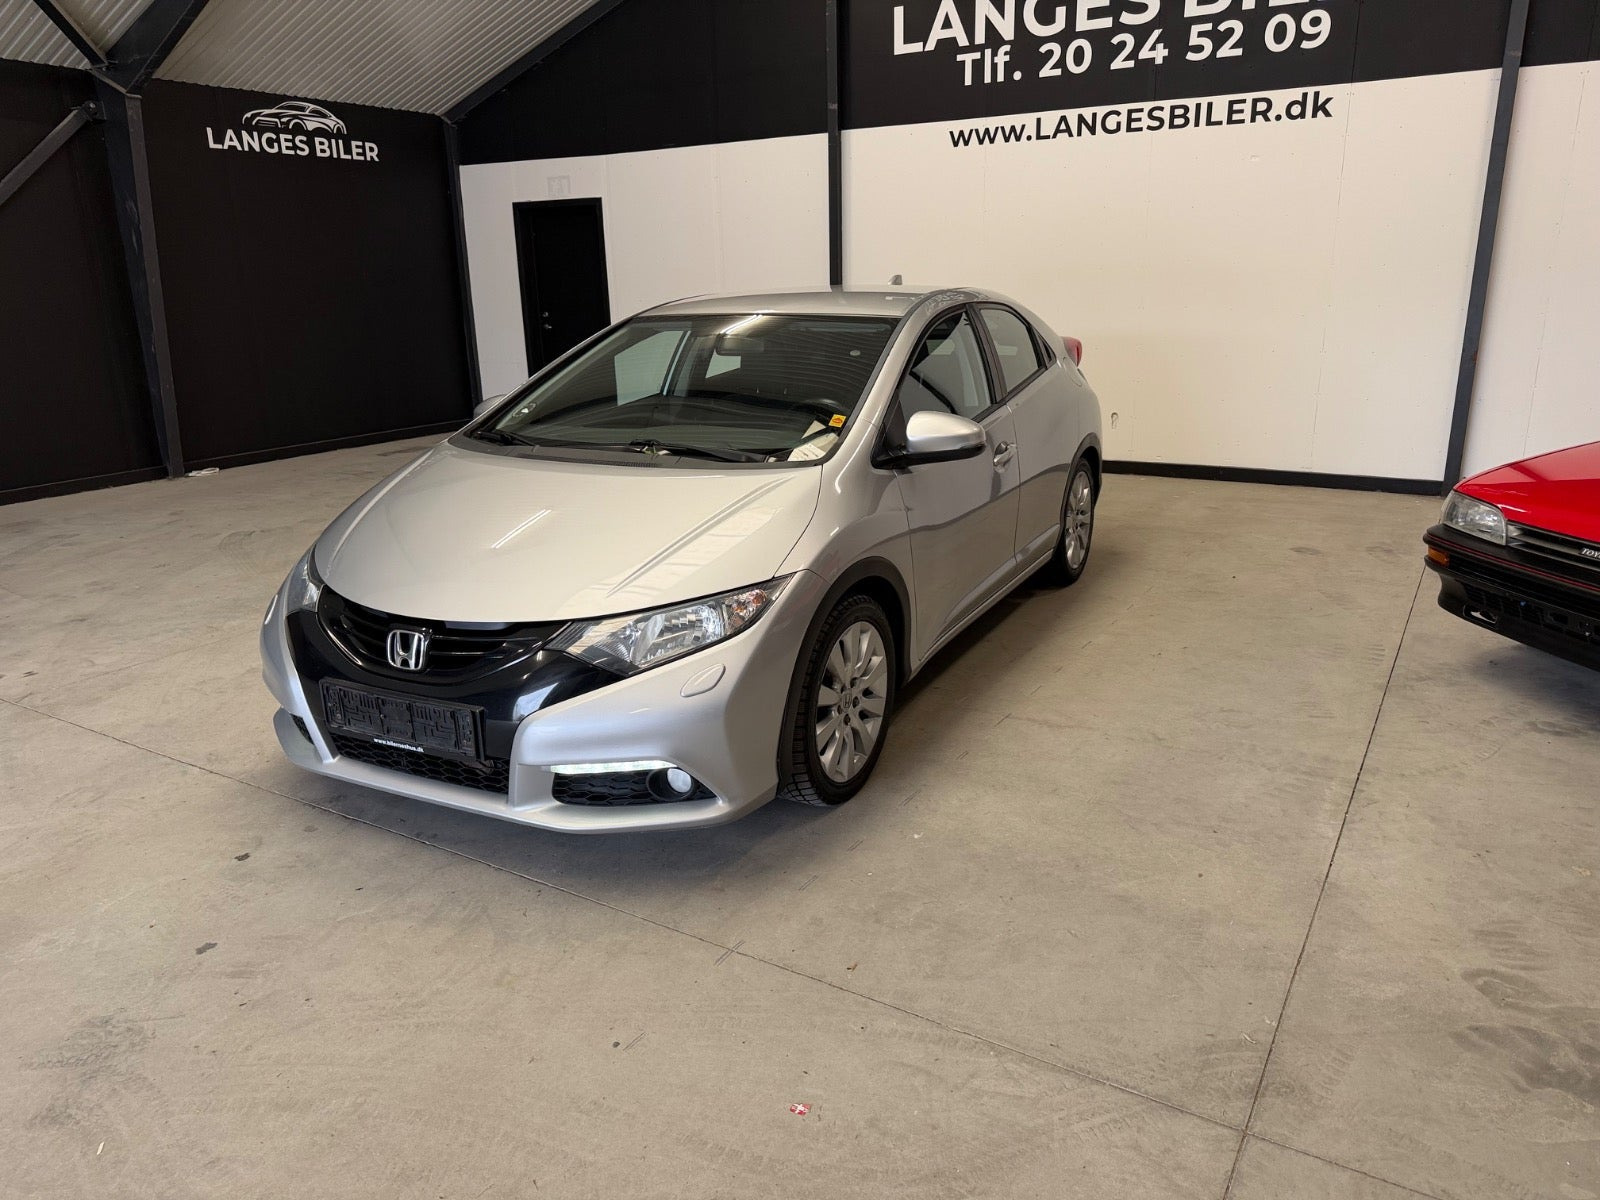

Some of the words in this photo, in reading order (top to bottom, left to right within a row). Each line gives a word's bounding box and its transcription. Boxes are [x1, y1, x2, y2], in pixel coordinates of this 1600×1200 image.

[957, 46, 1022, 86] Tlf.
[1038, 38, 1093, 78] 20
[1110, 28, 1169, 70] 24
[1185, 19, 1244, 61] 52
[1264, 9, 1331, 52] 09
[206, 127, 309, 155] LANGES
[314, 136, 379, 162] BILER
[949, 91, 1334, 148] www.LANGESBILER.dk
